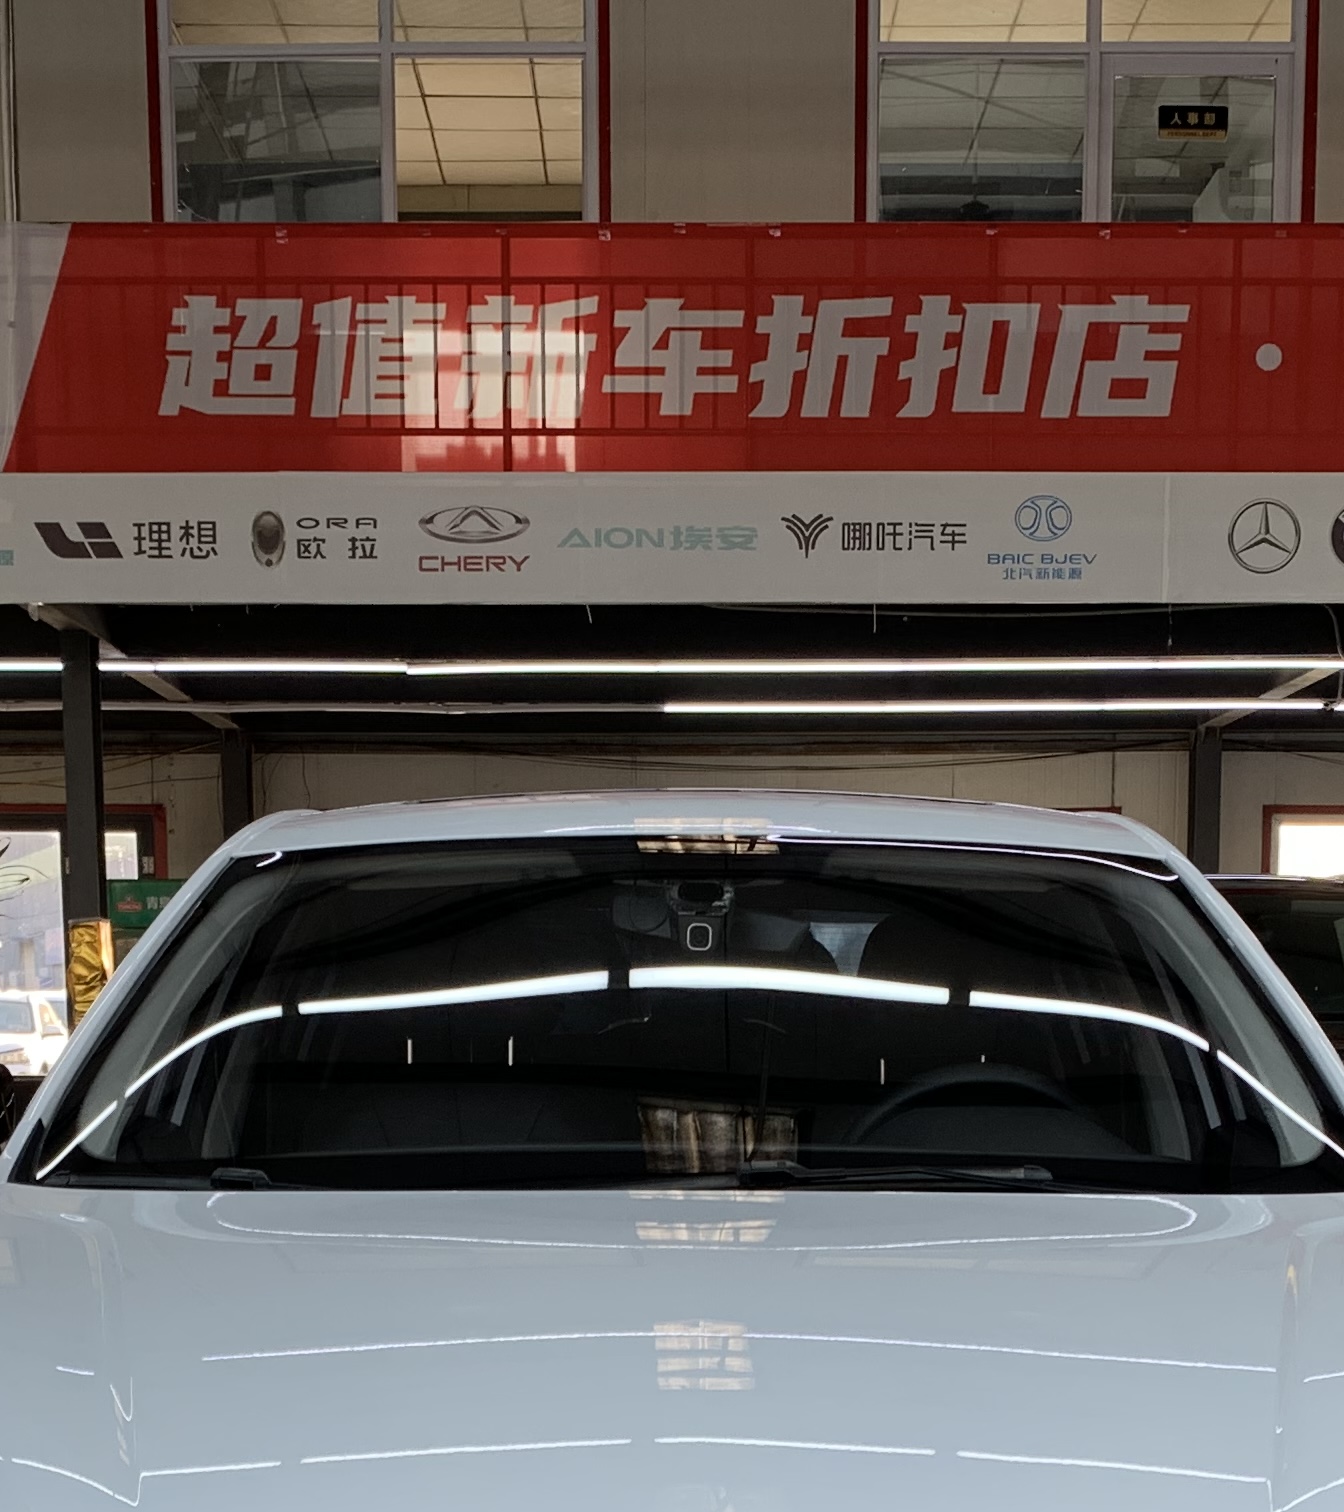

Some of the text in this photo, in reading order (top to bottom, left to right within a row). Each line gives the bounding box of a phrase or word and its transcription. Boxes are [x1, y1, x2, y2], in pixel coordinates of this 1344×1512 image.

[296, 517, 378, 530] ORA
[132, 521, 218, 560] 理想
[842, 521, 968, 552] 哪吒汽车
[297, 536, 378, 560] 欧拉
[418, 556, 530, 573] CHERY
[987, 553, 1097, 565] BAIC BJEV
[1002, 568, 1083, 580] 北汽新能源
